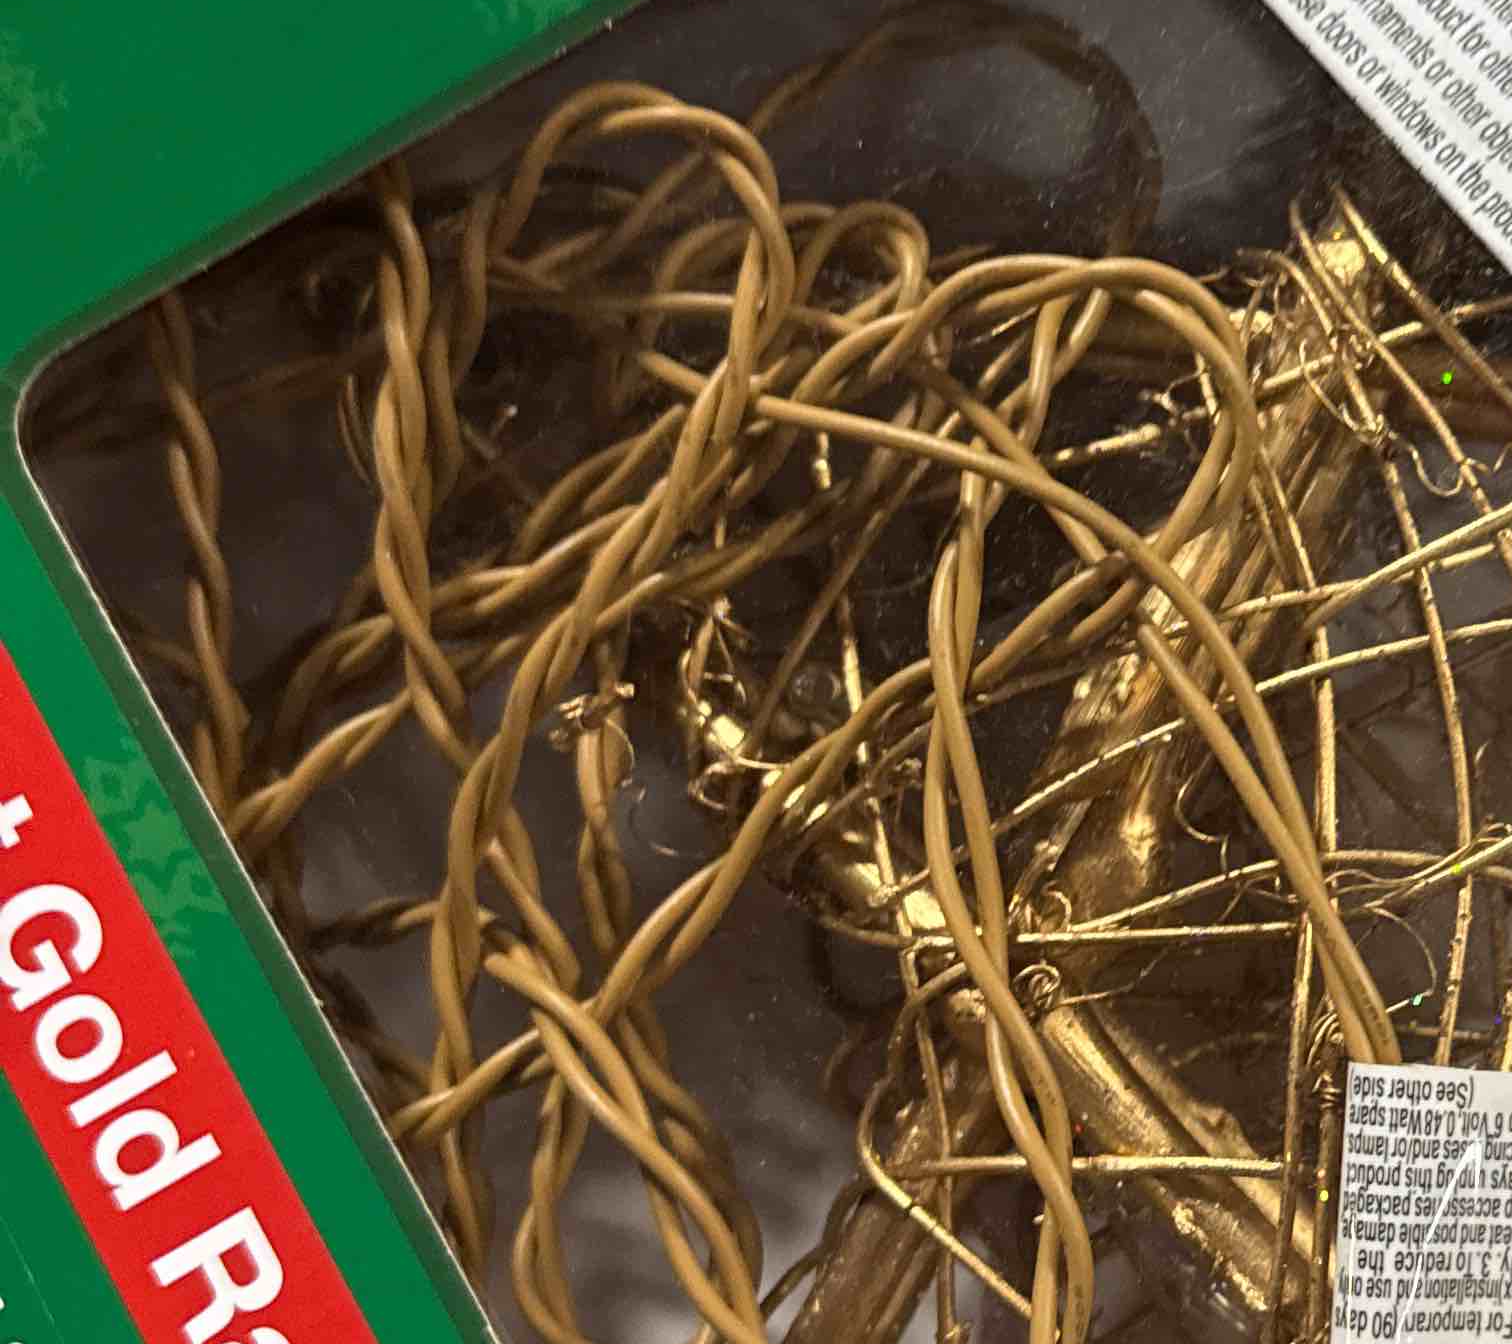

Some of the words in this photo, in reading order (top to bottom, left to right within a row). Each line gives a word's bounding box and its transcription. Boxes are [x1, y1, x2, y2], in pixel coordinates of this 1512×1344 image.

[1455, 19, 1494, 60] for
[1314, 7, 1370, 67] doors
[1354, 54, 1388, 85] or
[1372, 70, 1449, 152] windows
[1432, 140, 1468, 176] on
[1454, 158, 1494, 203] the
[1422, 58, 1454, 88] or
[1439, 75, 1495, 130] other
[0, 884, 222, 1210] Gold
[1386, 1077, 1432, 1105] other
[1435, 1074, 1474, 1109] (See
[1348, 1099, 1386, 1126] spare
[1493, 1111, 1503, 1138] 6
[1346, 1127, 1390, 1163] lamps
[1345, 1158, 1401, 1192] product
[1404, 1166, 1432, 1194] this
[1413, 1195, 1501, 1220] accessoies
[1458, 1223, 1486, 1249] and
[1357, 1248, 1384, 1276] the
[1365, 1276, 1392, 1298] use
